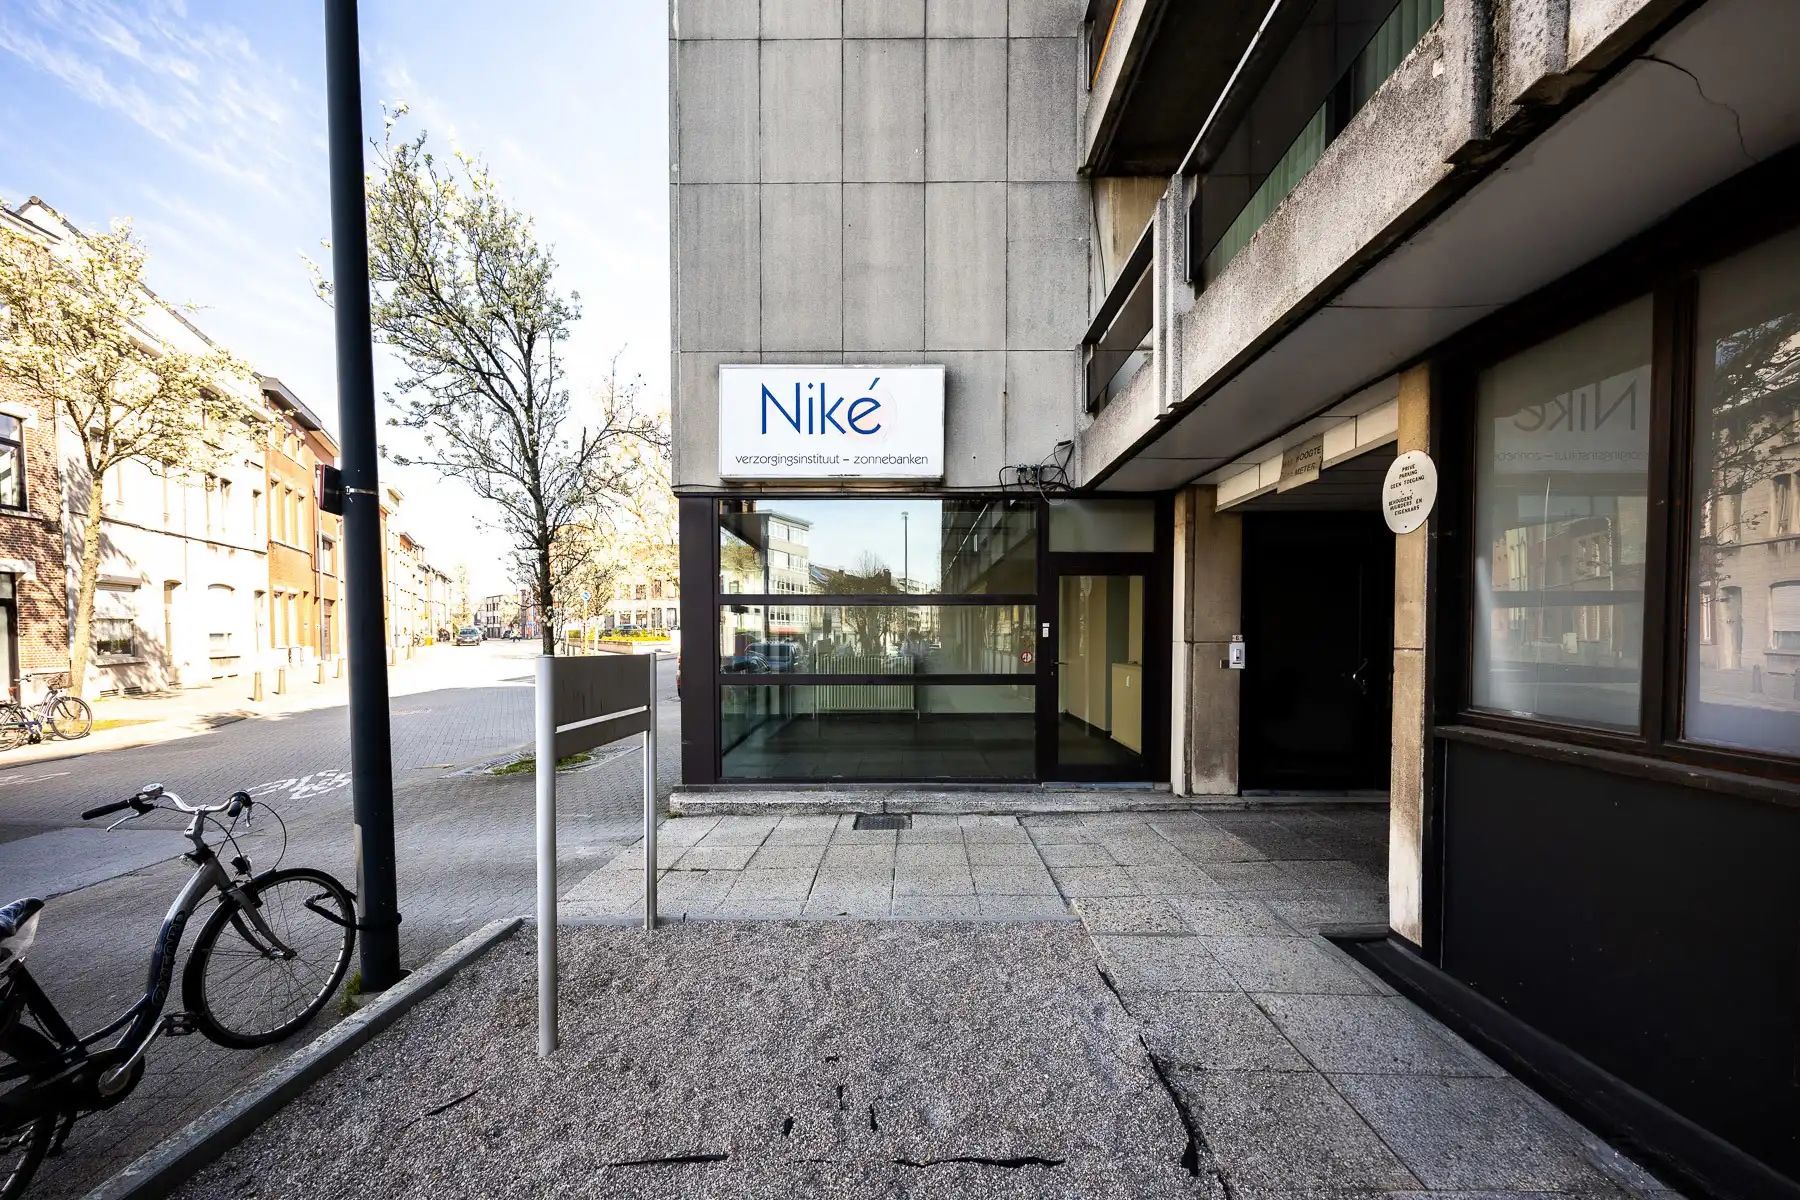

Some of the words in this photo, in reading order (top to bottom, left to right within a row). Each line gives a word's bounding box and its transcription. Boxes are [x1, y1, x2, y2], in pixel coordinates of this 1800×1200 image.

[761, 377, 881, 435] Niké
[735, 452, 840, 467] verzorgingsinstituut
[853, 452, 929, 465] zonnebanken
[1296, 446, 1321, 463] HOOGTE
[1295, 463, 1315, 475] METER
[1399, 470, 1418, 479] PARKING
[1403, 475, 1425, 485] TOEGANG
